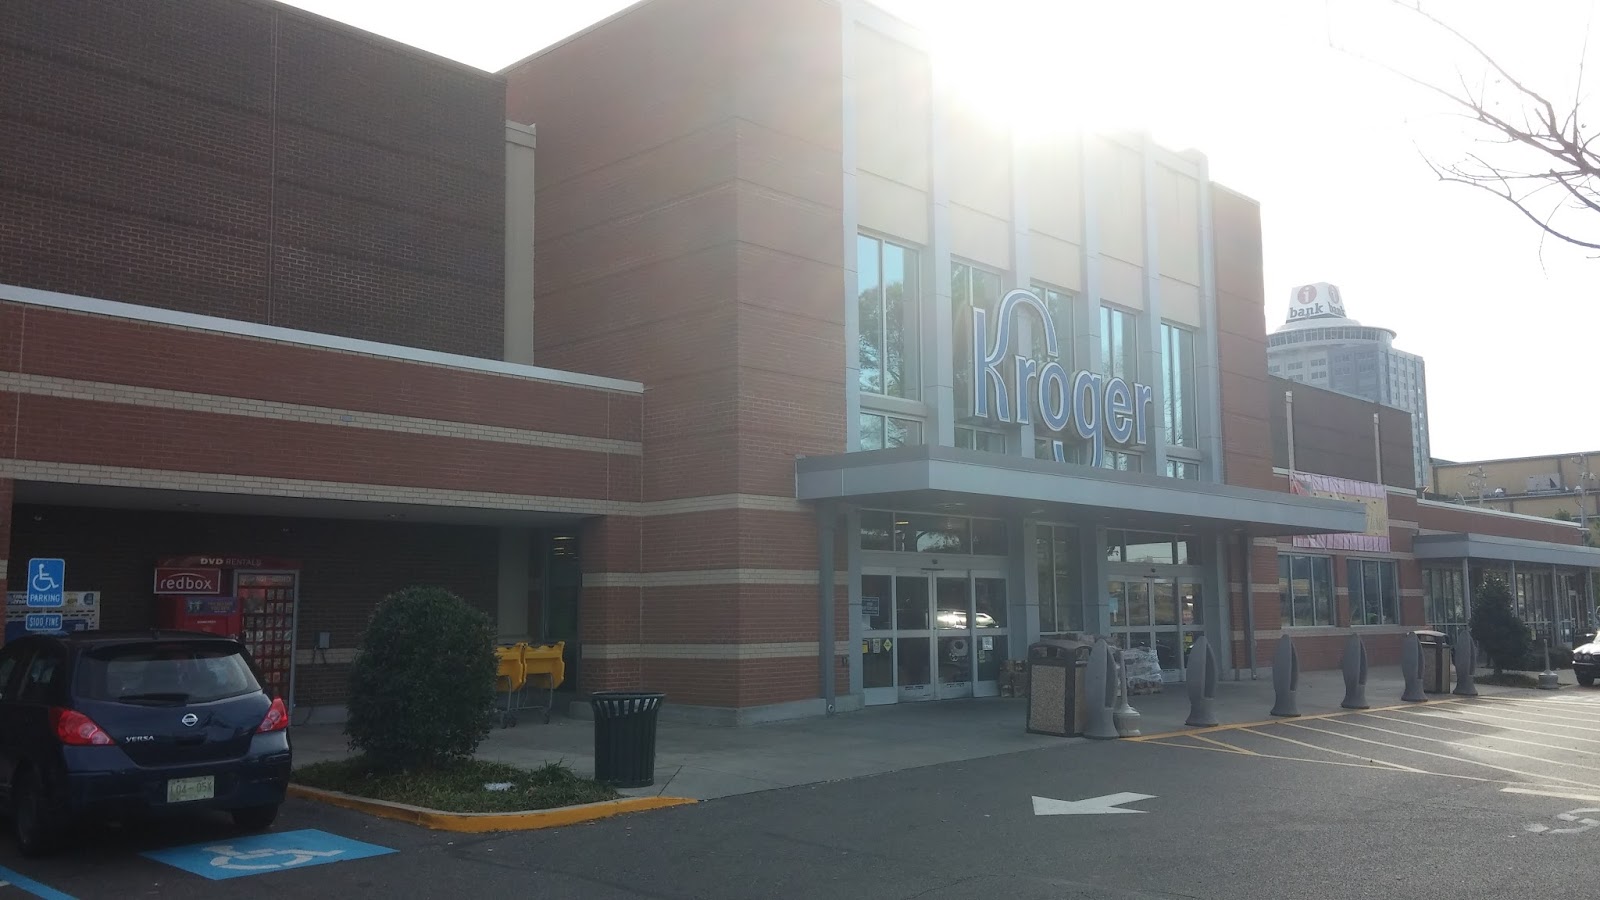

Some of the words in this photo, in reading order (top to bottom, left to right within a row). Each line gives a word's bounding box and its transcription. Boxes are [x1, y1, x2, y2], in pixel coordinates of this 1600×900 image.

[1290, 303, 1323, 318] bank
[1328, 301, 1346, 317] bank
[973, 289, 1152, 467] Kroger
[160, 576, 212, 590] redbox
[30, 594, 60, 603] PARKING
[29, 617, 44, 627] $100
[45, 617, 59, 626] FINE
